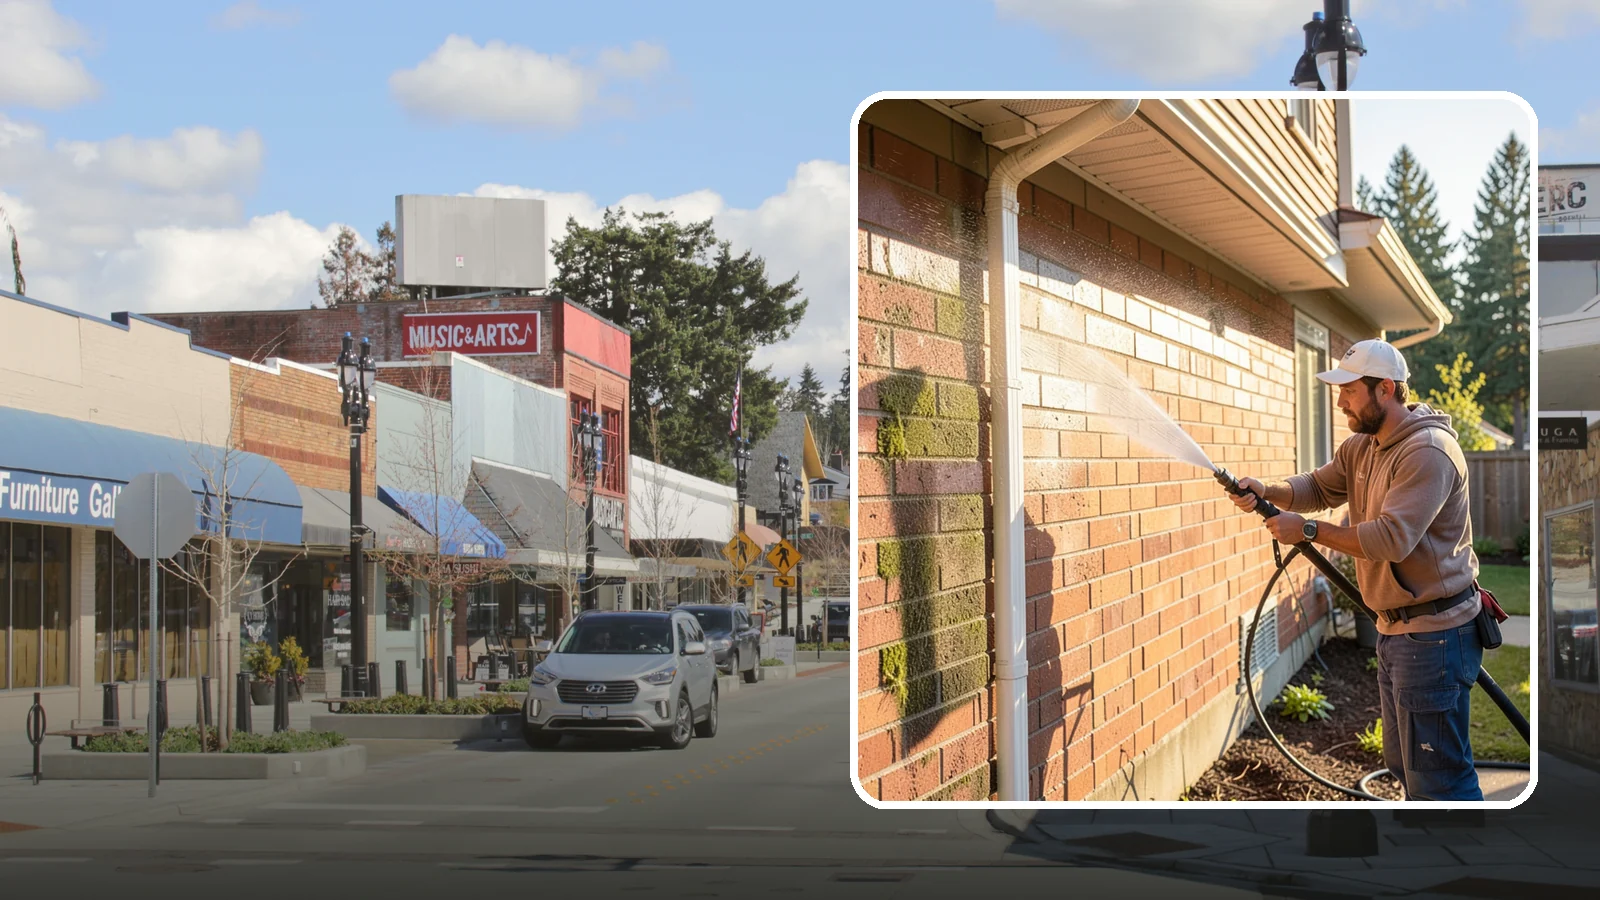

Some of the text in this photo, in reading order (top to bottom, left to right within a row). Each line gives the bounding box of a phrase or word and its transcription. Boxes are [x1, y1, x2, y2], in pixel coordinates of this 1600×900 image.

[1540, 428, 1577, 436] UGA
[0, 472, 121, 519] Furniture Gal
[454, 563, 479, 574] SUSHI
